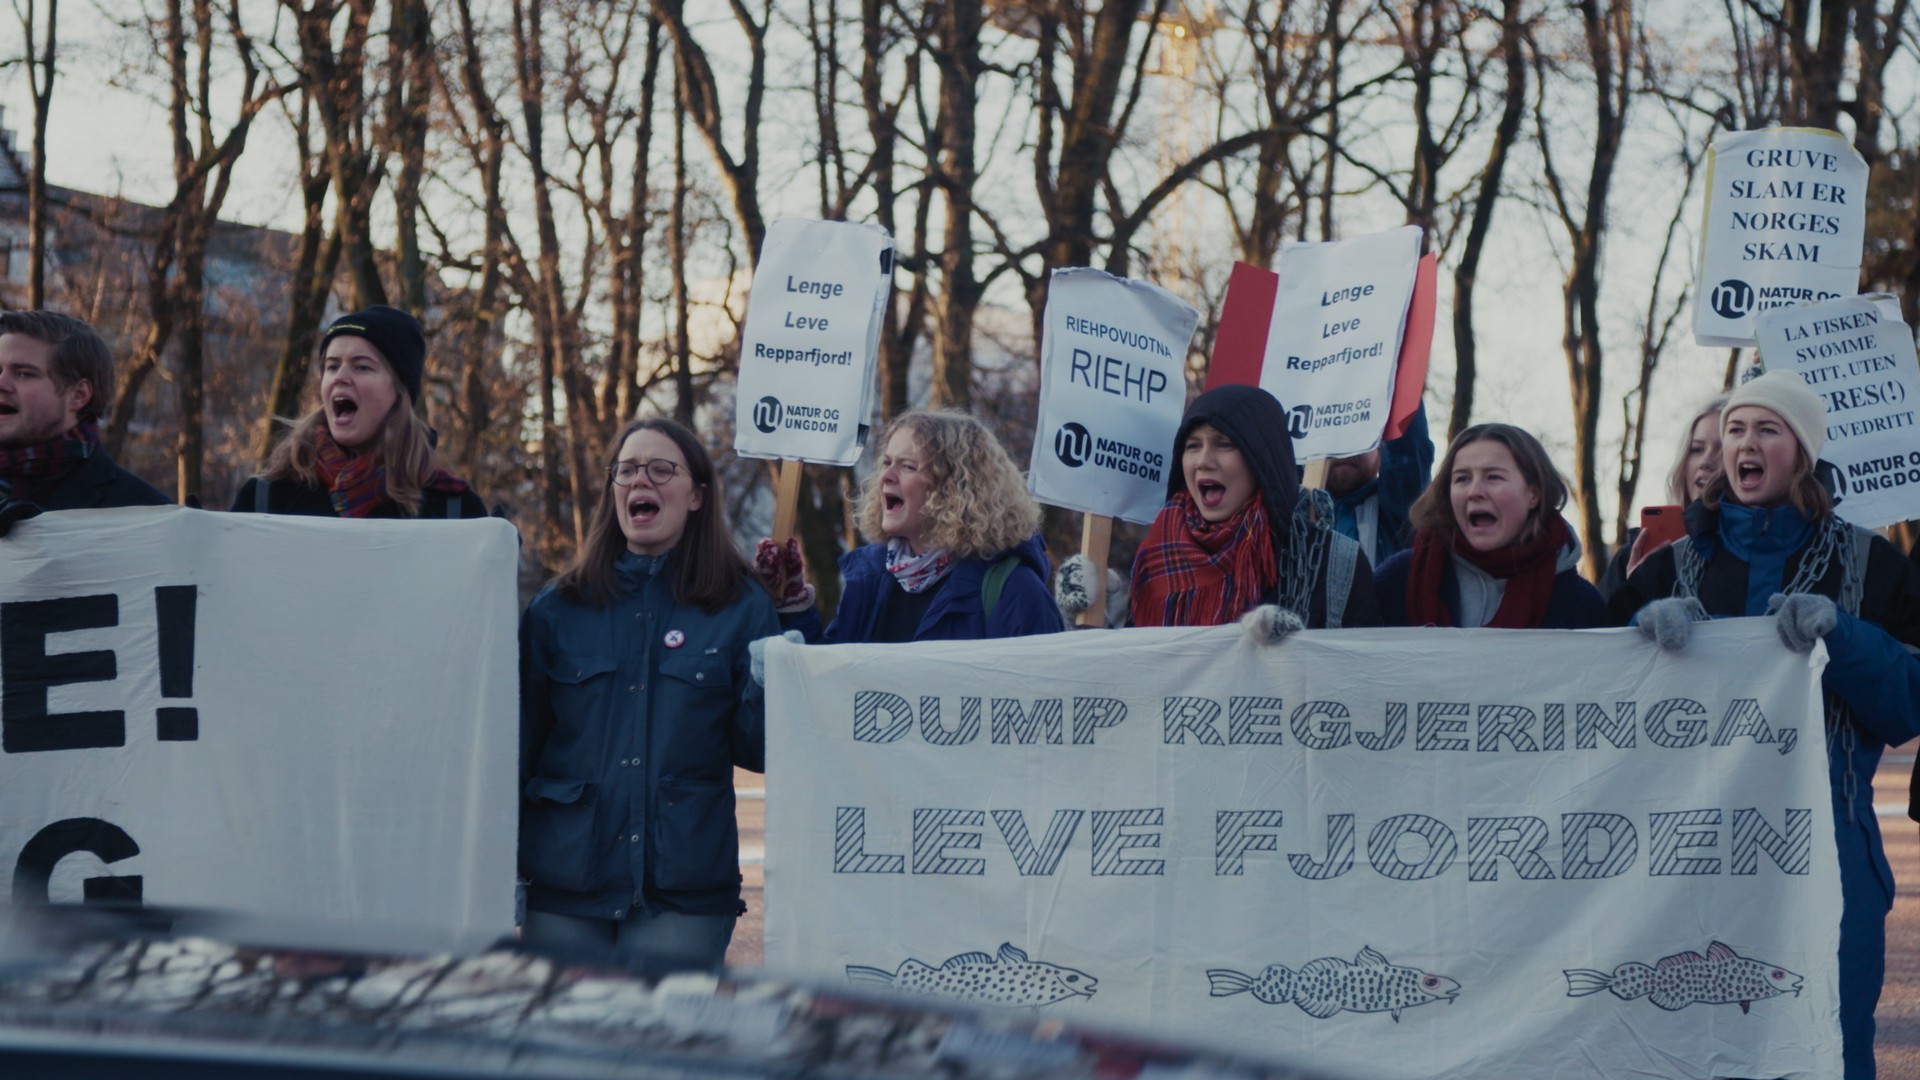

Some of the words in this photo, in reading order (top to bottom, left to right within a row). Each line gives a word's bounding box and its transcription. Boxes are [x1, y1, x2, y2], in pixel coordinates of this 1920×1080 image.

[1747, 149, 1838, 173] GRUVE
[1730, 179, 1804, 200] SLAM
[1812, 183, 1847, 205] ER
[1730, 211, 1840, 235] NORGES
[1742, 242, 1822, 263] SKAM
[786, 275, 844, 300] Lenge
[1321, 284, 1375, 307] Lenge
[1759, 286, 1814, 301] NATUR
[784, 311, 829, 331] Leve
[1322, 317, 1361, 339] Leve
[1784, 325, 1810, 342] LA
[1813, 310, 1879, 337] FISKEN
[1066, 315, 1172, 360] RIEHPOVUOTNA
[1796, 334, 1878, 364] SVØMME
[755, 343, 852, 367] Repparfjord!
[1286, 342, 1383, 374] Repparfjord!
[1070, 348, 1167, 404] RIEHP
[1799, 364, 1847, 385] RITT,
[1848, 354, 1897, 376] UTEN
[786, 405, 821, 419] NATUR
[823, 408, 840, 420] OG
[1316, 402, 1353, 416] NATUR
[1355, 398, 1371, 412] OG
[785, 419, 838, 434] UNGDOM
[1314, 411, 1370, 429] UNGDOM
[1825, 411, 1915, 441] UVEDRITT
[1096, 437, 1141, 462] NATUR
[1143, 450, 1163, 467] OG
[1848, 454, 1906, 478] NATUR
[1909, 451, 1920, 465] O
[1094, 453, 1161, 483] UNGDOM
[1852, 469, 1920, 494] UNGDO
[853, 690, 1128, 746] DUMP
[1163, 696, 1797, 756] REGJERINGA,
[833, 806, 1166, 876] LEVE
[1215, 807, 1812, 882] FJORDEN
